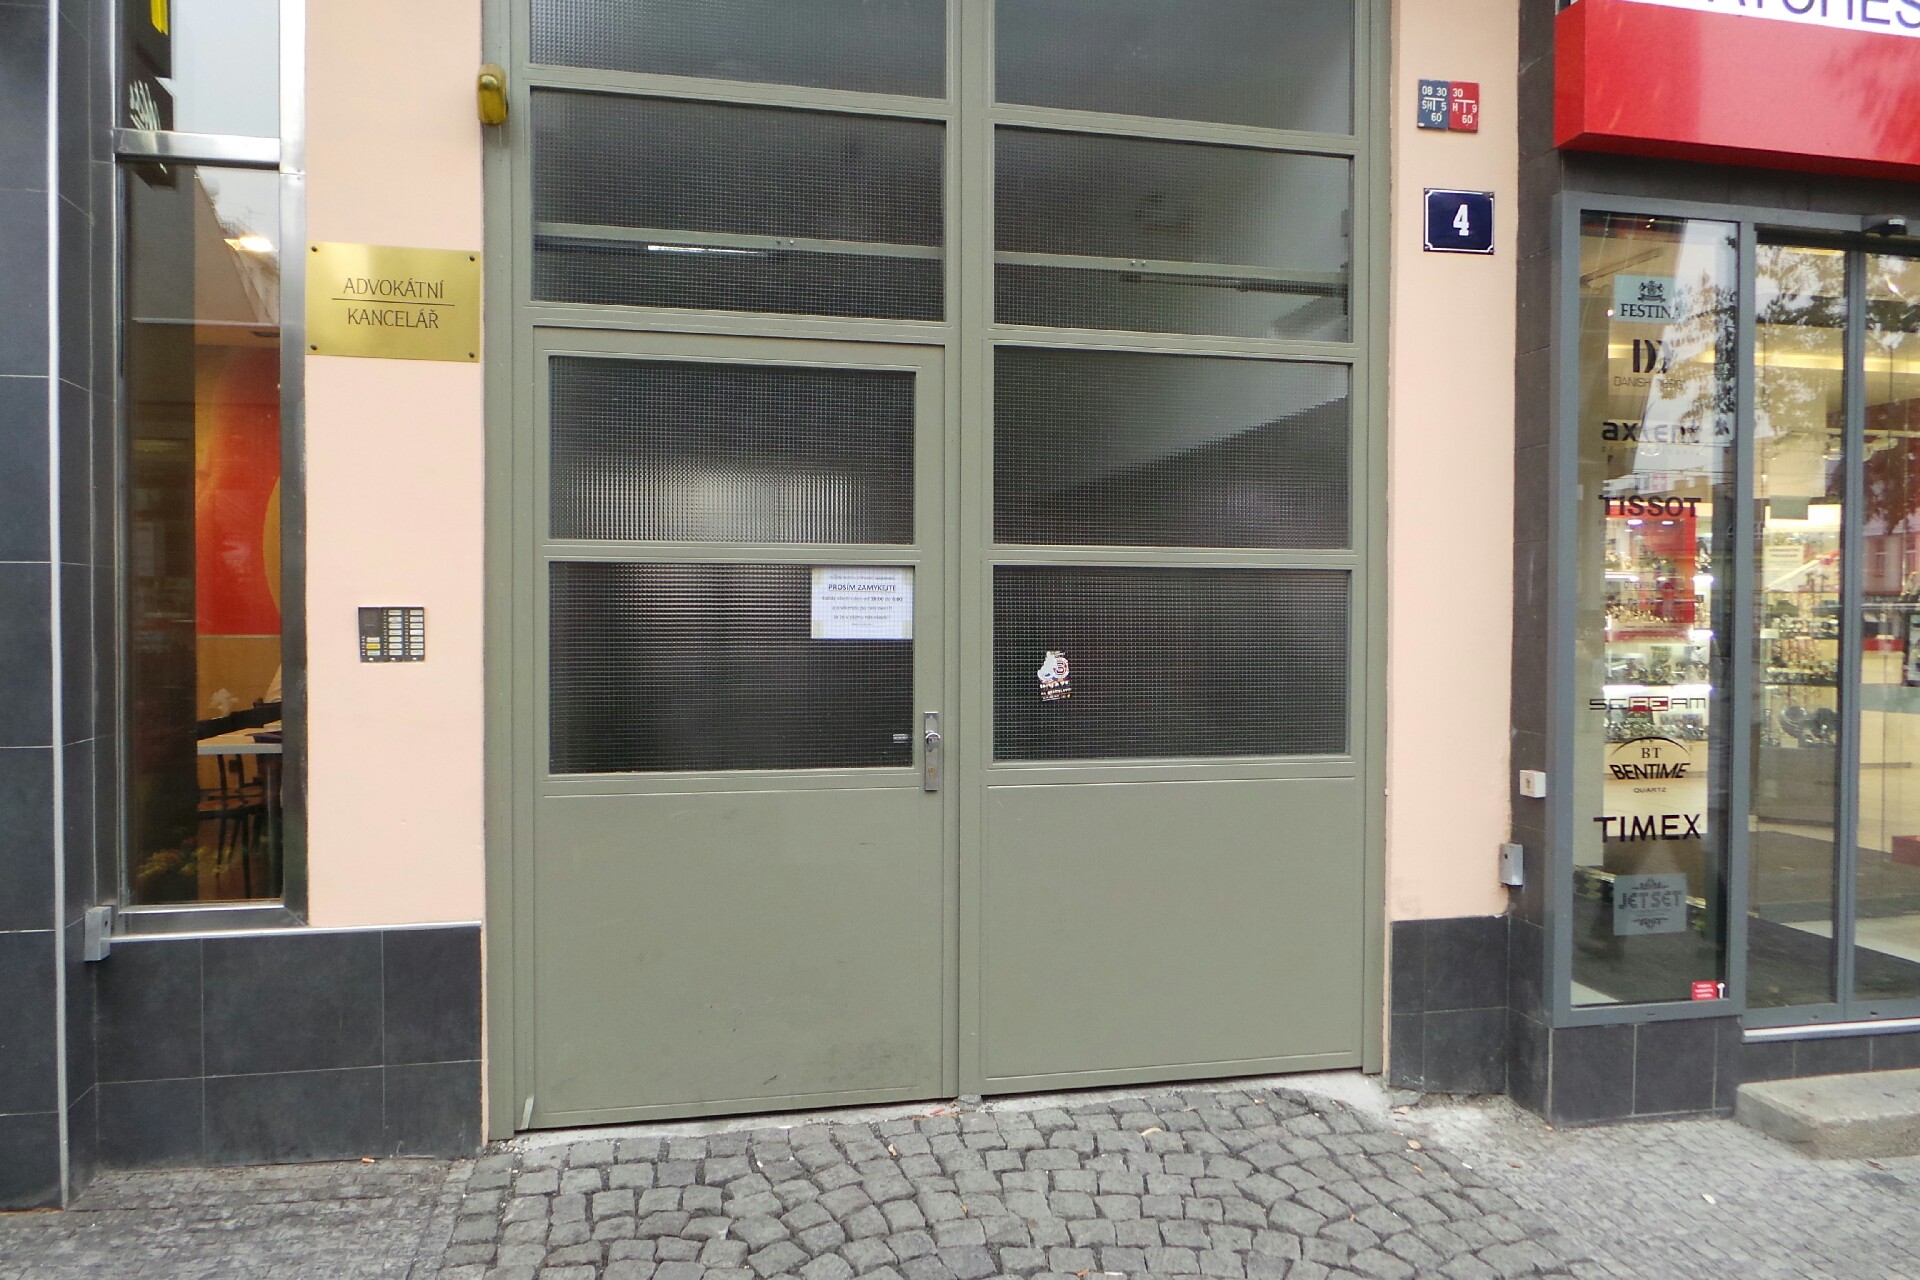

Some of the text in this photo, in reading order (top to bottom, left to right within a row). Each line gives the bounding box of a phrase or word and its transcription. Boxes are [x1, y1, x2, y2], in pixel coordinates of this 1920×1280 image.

[1436, 87, 1447, 97] 30
[1452, 88, 1463, 98] 30
[1453, 204, 1469, 236] 4
[343, 278, 444, 299] ADVOKÁTNÍ
[348, 308, 439, 329] KANCELÁŘ
[1598, 495, 1702, 517] TISSOT
[828, 582, 896, 592] PROSÍM ZAMYKEJTE
[1590, 696, 1705, 712] SCREAM
[1642, 747, 1662, 758] BT
[1609, 763, 1691, 780] BENTIME
[1593, 814, 1701, 843] TIMEX
